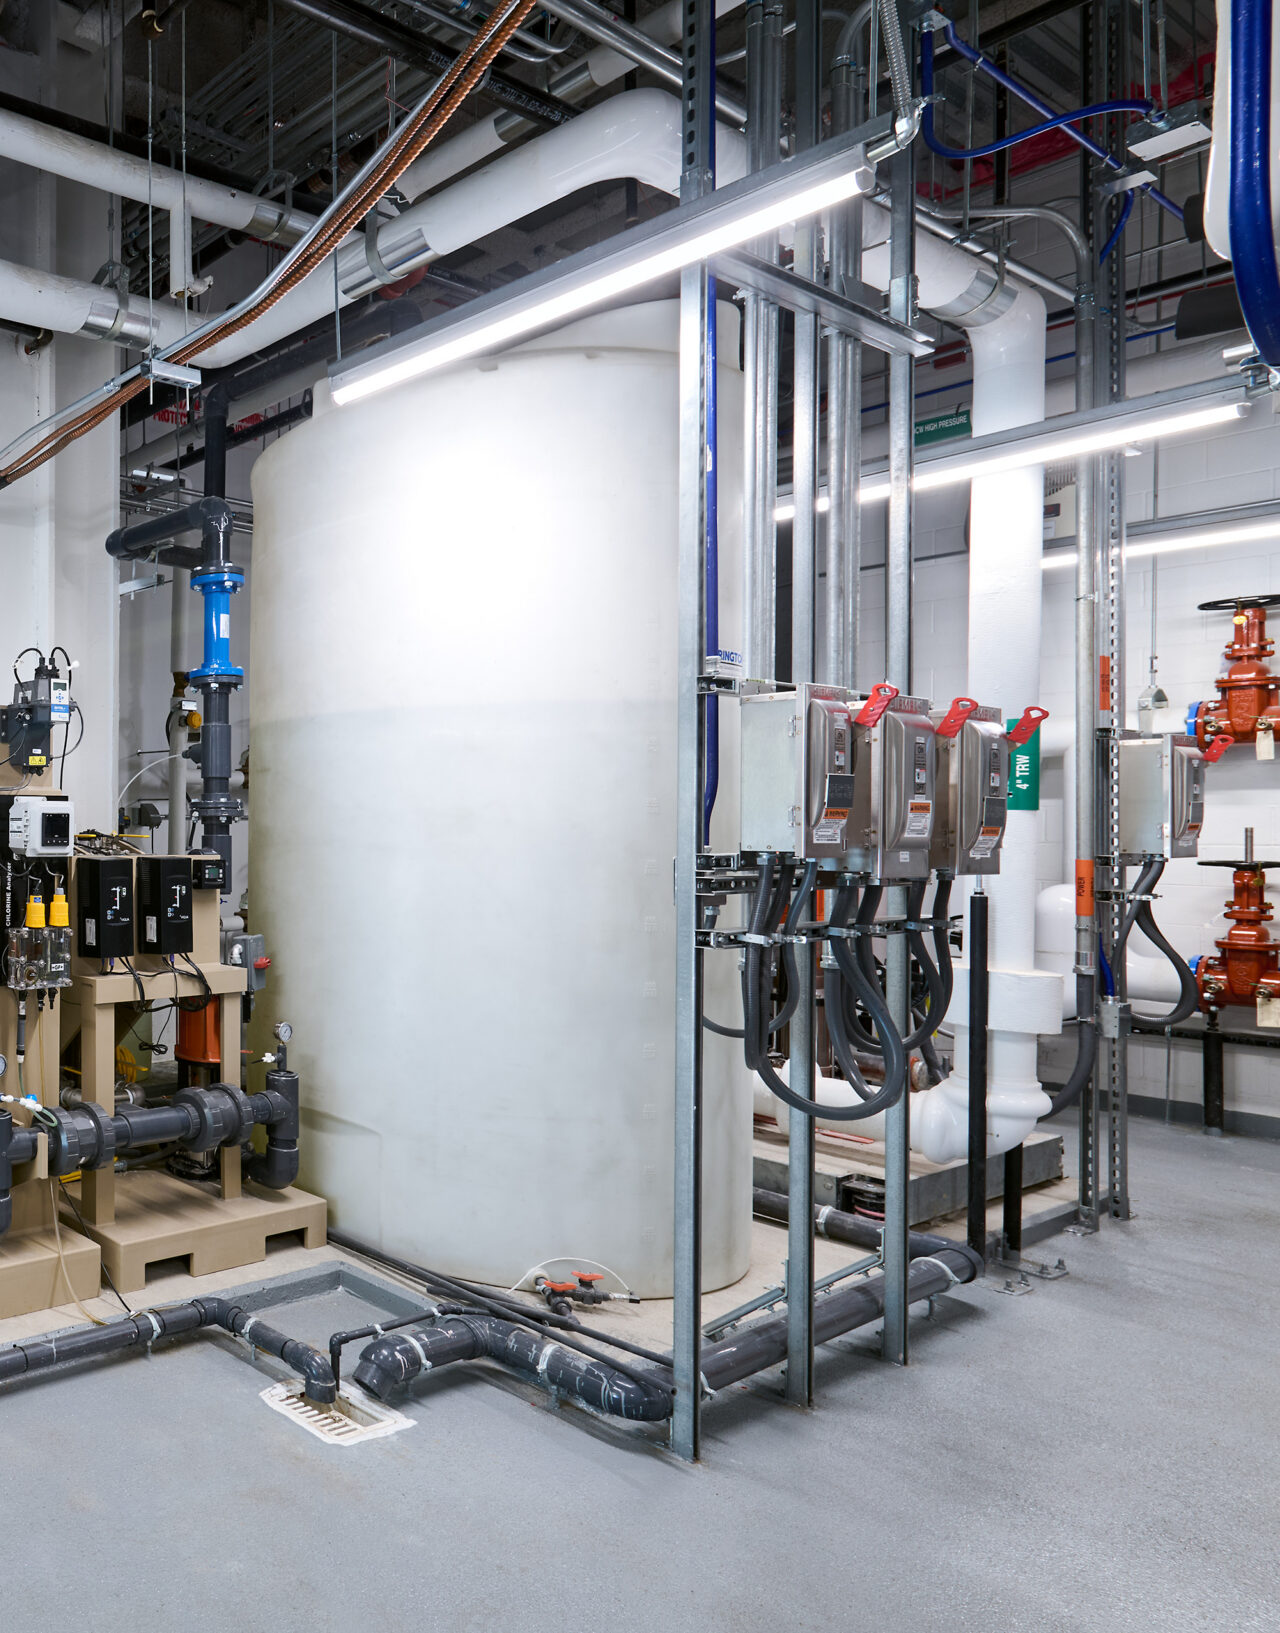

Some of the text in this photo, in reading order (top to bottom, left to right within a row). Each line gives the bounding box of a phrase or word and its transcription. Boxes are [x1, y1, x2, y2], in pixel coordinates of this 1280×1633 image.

[924, 422, 937, 432] HIGH
[938, 415, 968, 429] PRESSURE
[718, 649, 743, 664] RINGTO
[1016, 754, 1030, 790] 4" TRW
[1077, 876, 1086, 897] POWER
